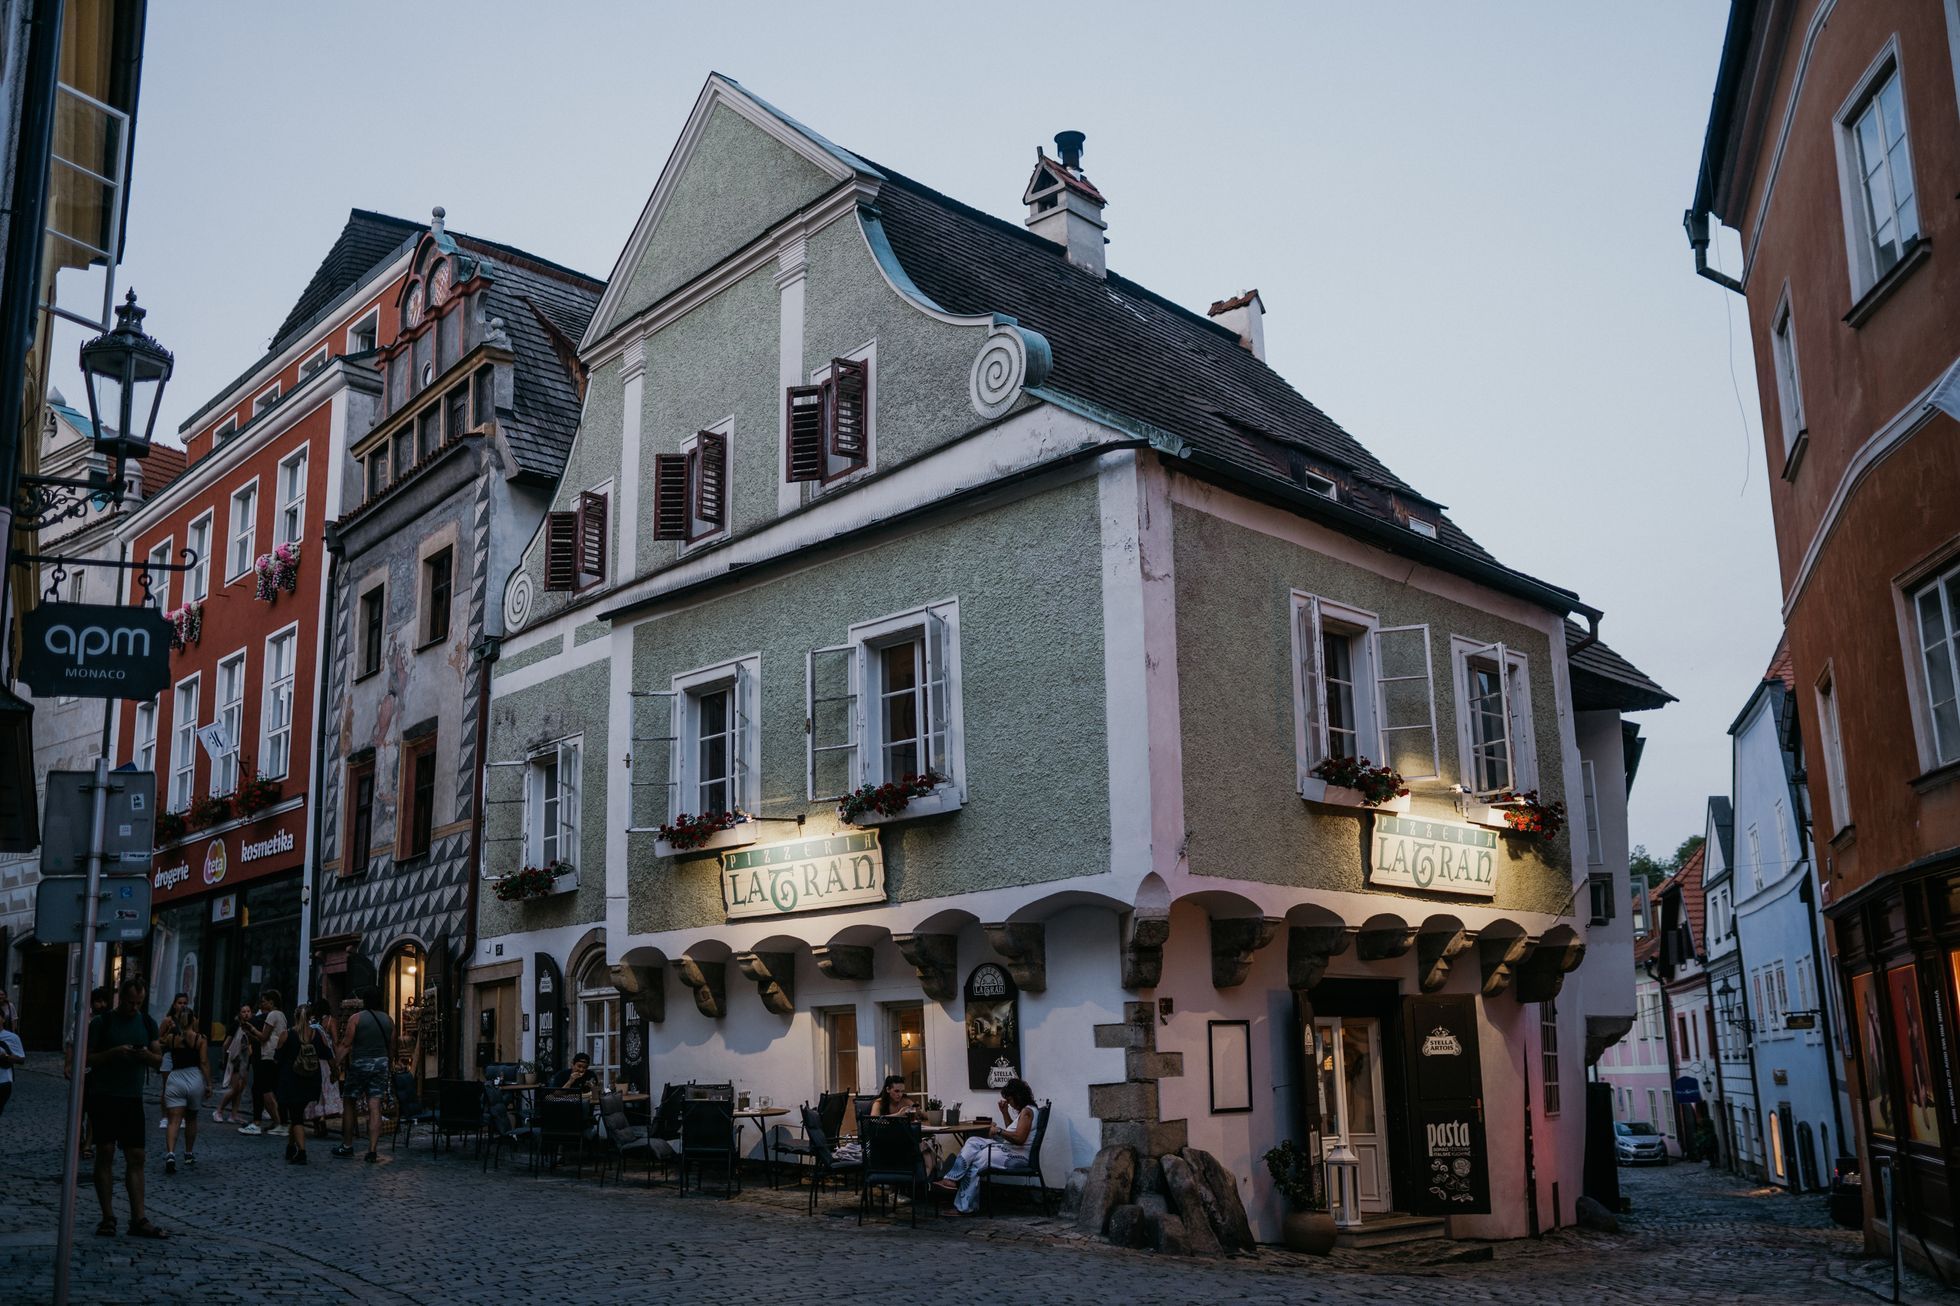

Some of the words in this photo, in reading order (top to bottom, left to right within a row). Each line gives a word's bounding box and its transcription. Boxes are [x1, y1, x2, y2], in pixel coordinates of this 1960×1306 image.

[44, 624, 151, 666] apm
[65, 668, 126, 680] MONACO
[1381, 816, 1493, 847] PIZZERIA
[154, 859, 190, 890] drogerie
[207, 856, 223, 875] teta
[240, 828, 294, 863] kosmetika
[729, 834, 873, 868] PIZZERIA
[1426, 1119, 1471, 1157] pasta
